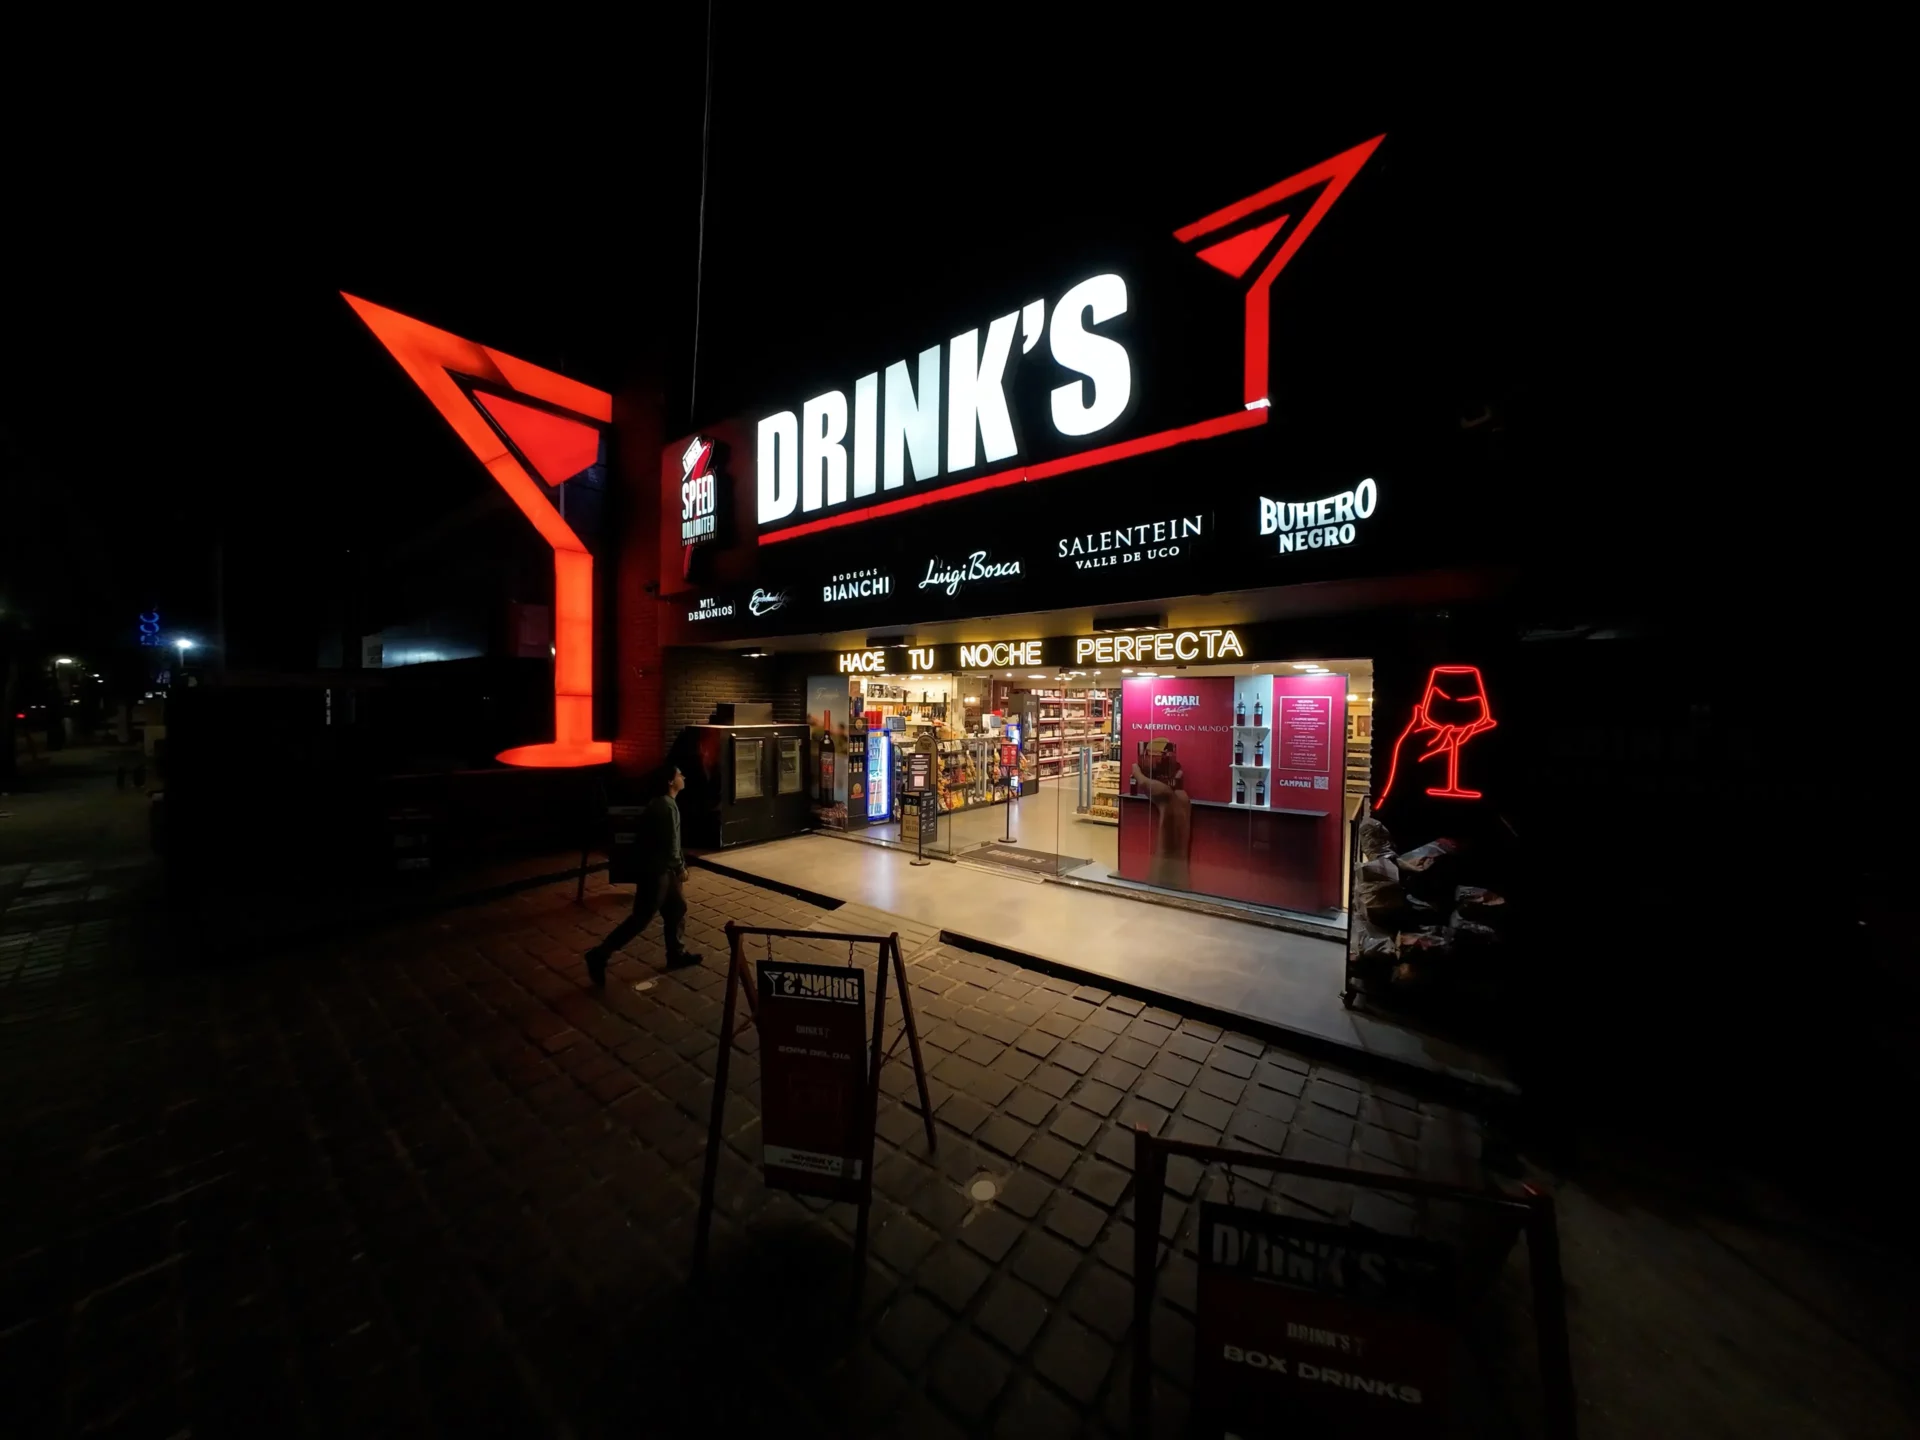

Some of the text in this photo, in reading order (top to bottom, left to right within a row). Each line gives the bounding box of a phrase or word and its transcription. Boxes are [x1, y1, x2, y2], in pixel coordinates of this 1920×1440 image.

[757, 273, 1132, 525] DRINK'S
[682, 474, 715, 520] SPEED
[1259, 477, 1378, 536] BUHERO
[682, 515, 715, 540] UNLIMITED
[1058, 515, 1203, 558] SALENTEIN
[1278, 523, 1357, 554] NEGRO
[1076, 546, 1181, 570] VALLE DE UCO
[832, 569, 879, 582] BODEGAS
[918, 550, 1021, 596] Luigi Bosca
[823, 576, 890, 602] BIANCHI
[688, 605, 733, 622] DEMONIOS
[700, 597, 716, 609] MIL
[839, 629, 1244, 673] HACE TU NOCHE PERFECTA
[1154, 694, 1200, 706] CAMPARI
[1198, 725, 1229, 733] MUNDO
[1279, 779, 1311, 788] CAMPARI
[1223, 1343, 1424, 1404] BOX DRINKS
